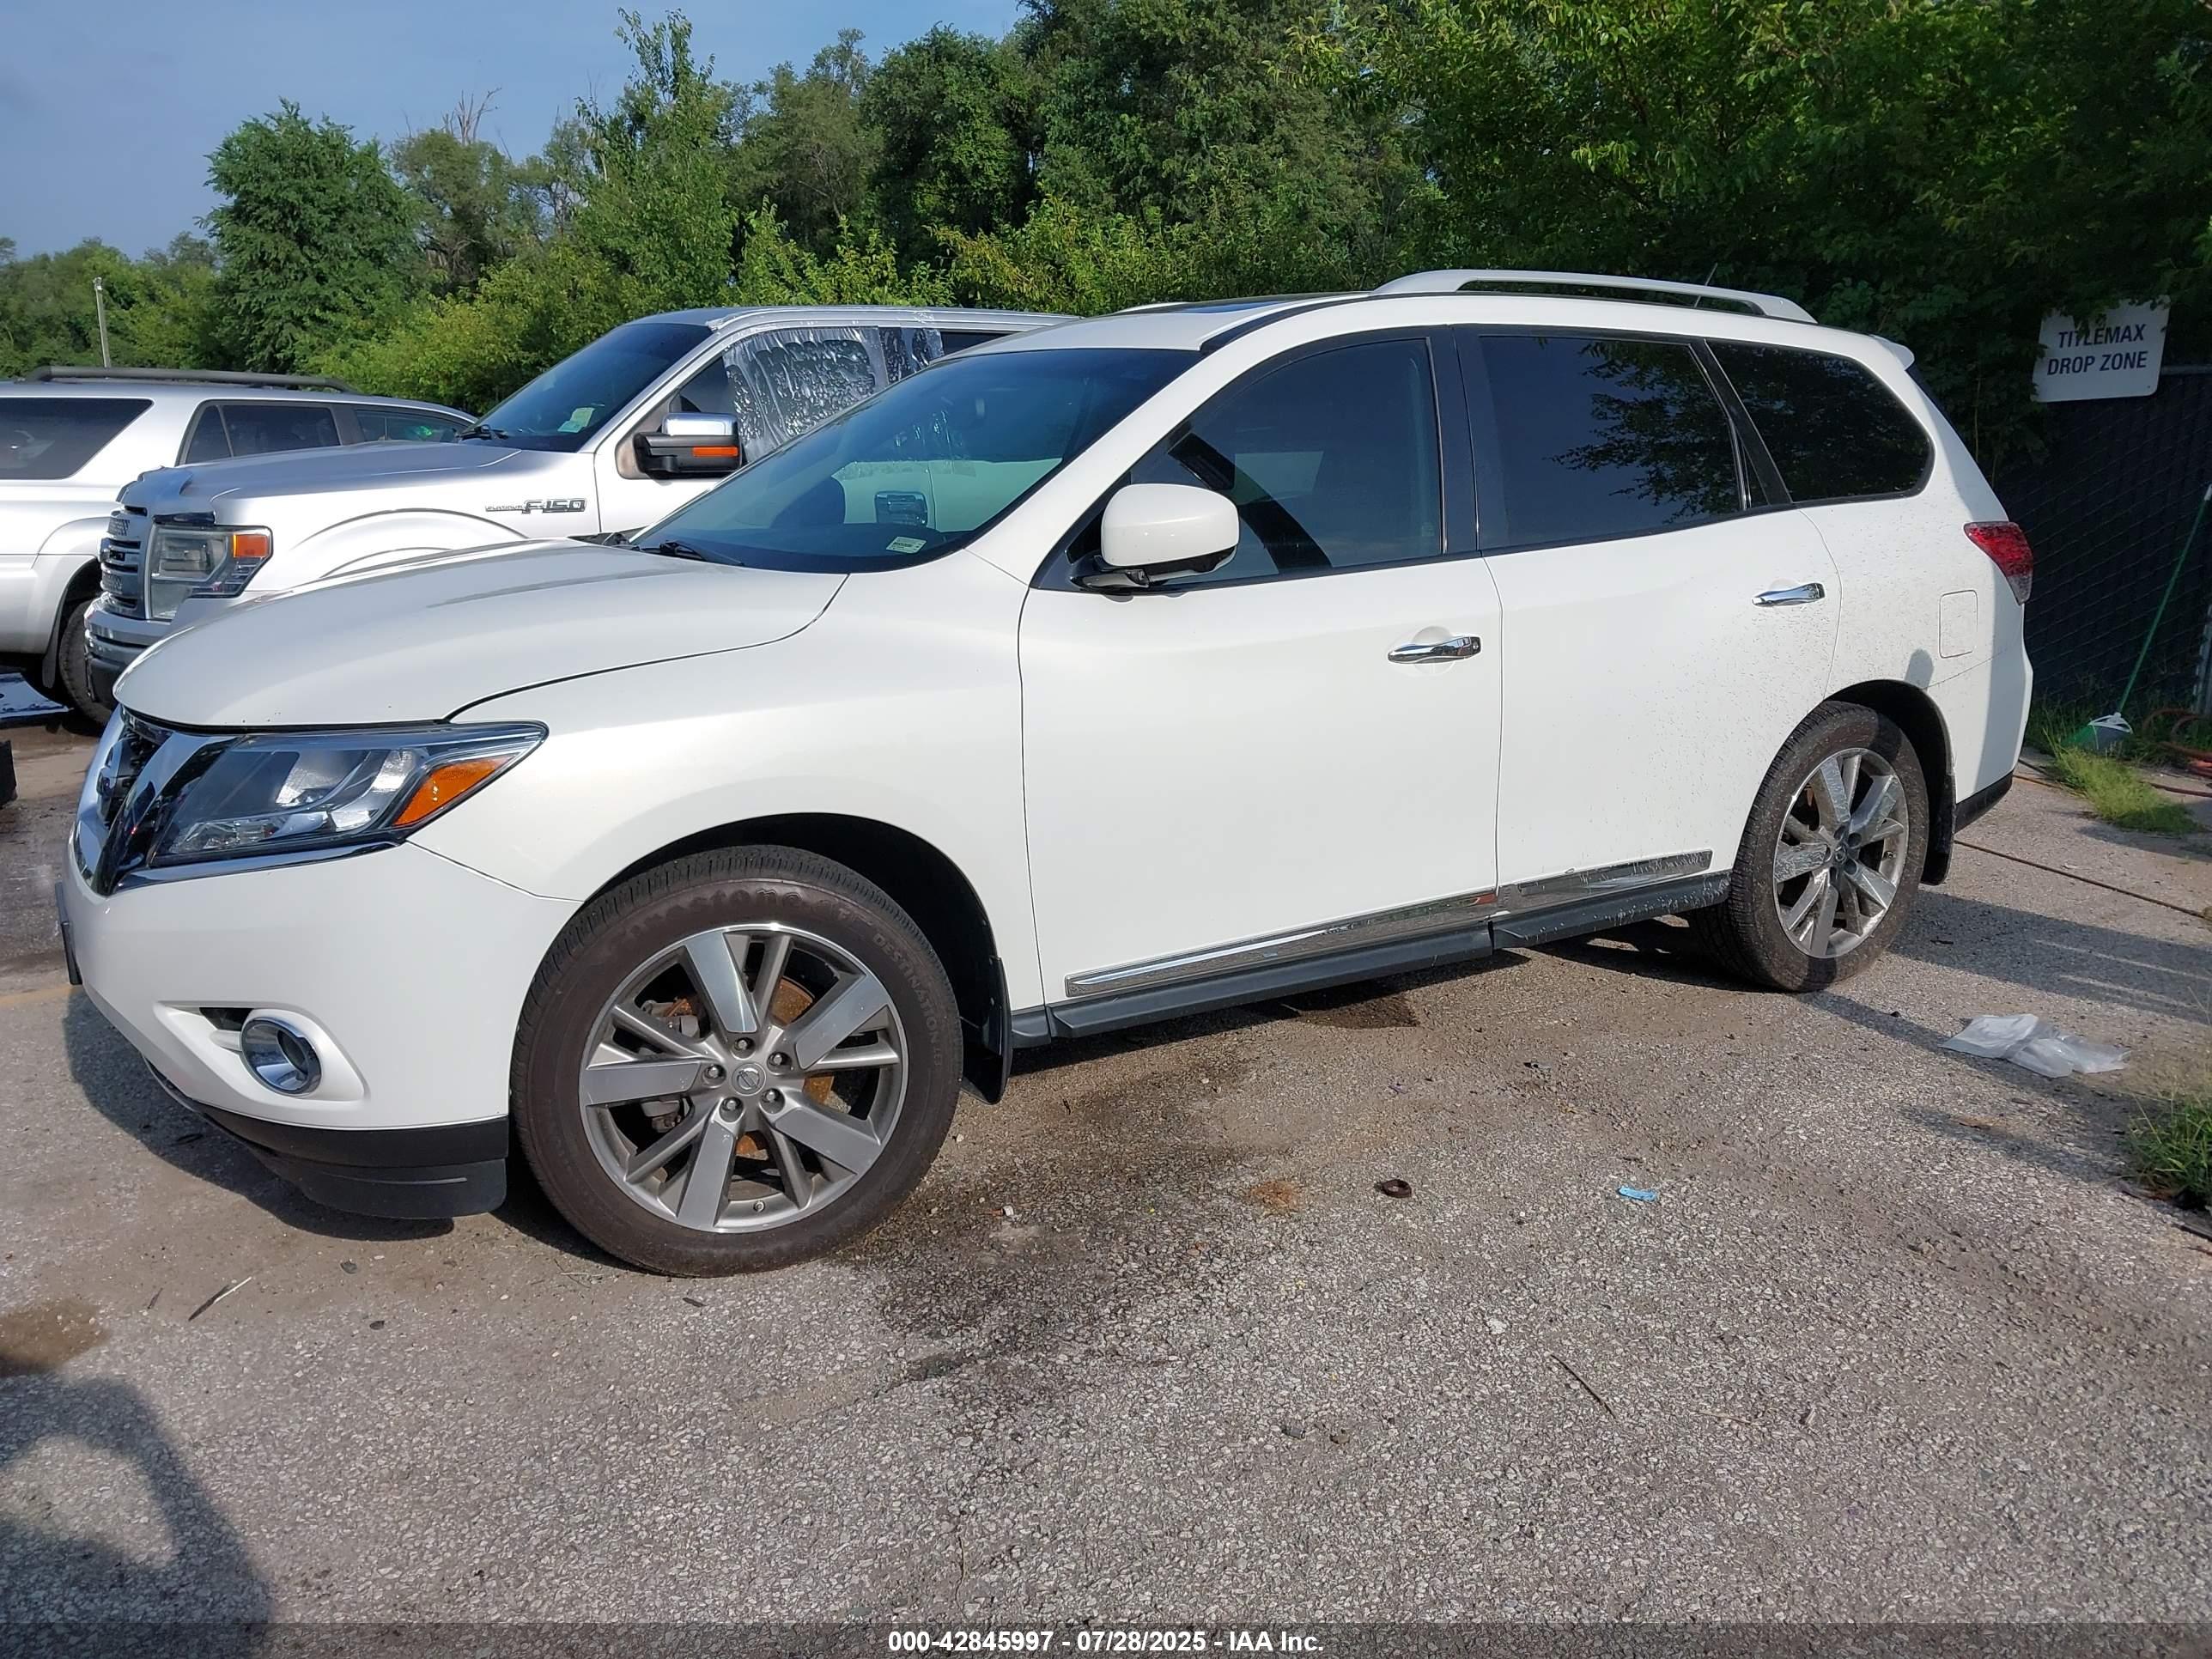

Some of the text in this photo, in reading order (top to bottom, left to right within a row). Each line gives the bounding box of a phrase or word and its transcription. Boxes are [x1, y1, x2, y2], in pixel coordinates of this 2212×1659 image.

[2058, 324, 2147, 349] TITLEMAX
[2047, 350, 2148, 375] DROP ZONE
